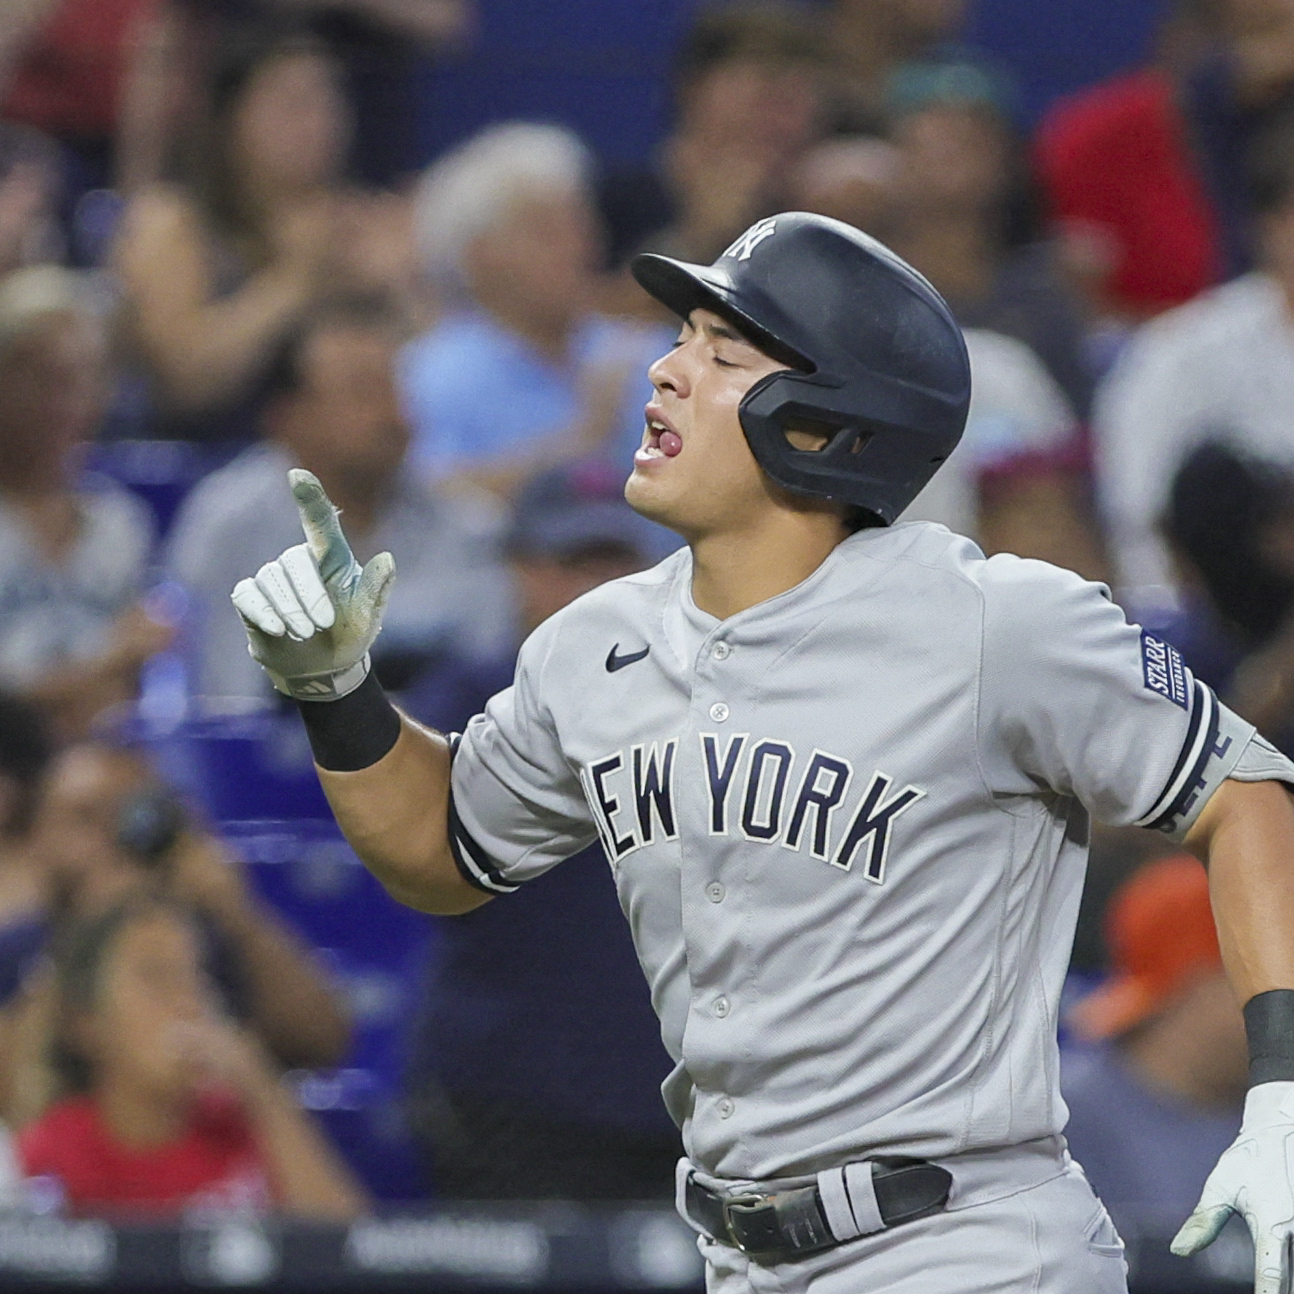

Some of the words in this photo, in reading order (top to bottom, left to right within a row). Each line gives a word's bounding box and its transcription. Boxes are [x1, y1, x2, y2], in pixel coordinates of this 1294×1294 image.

[1144, 635, 1170, 697] STARR
[1170, 650, 1186, 704] INSURANCE
[581, 736, 681, 866] EW
[699, 732, 928, 886] YORK
